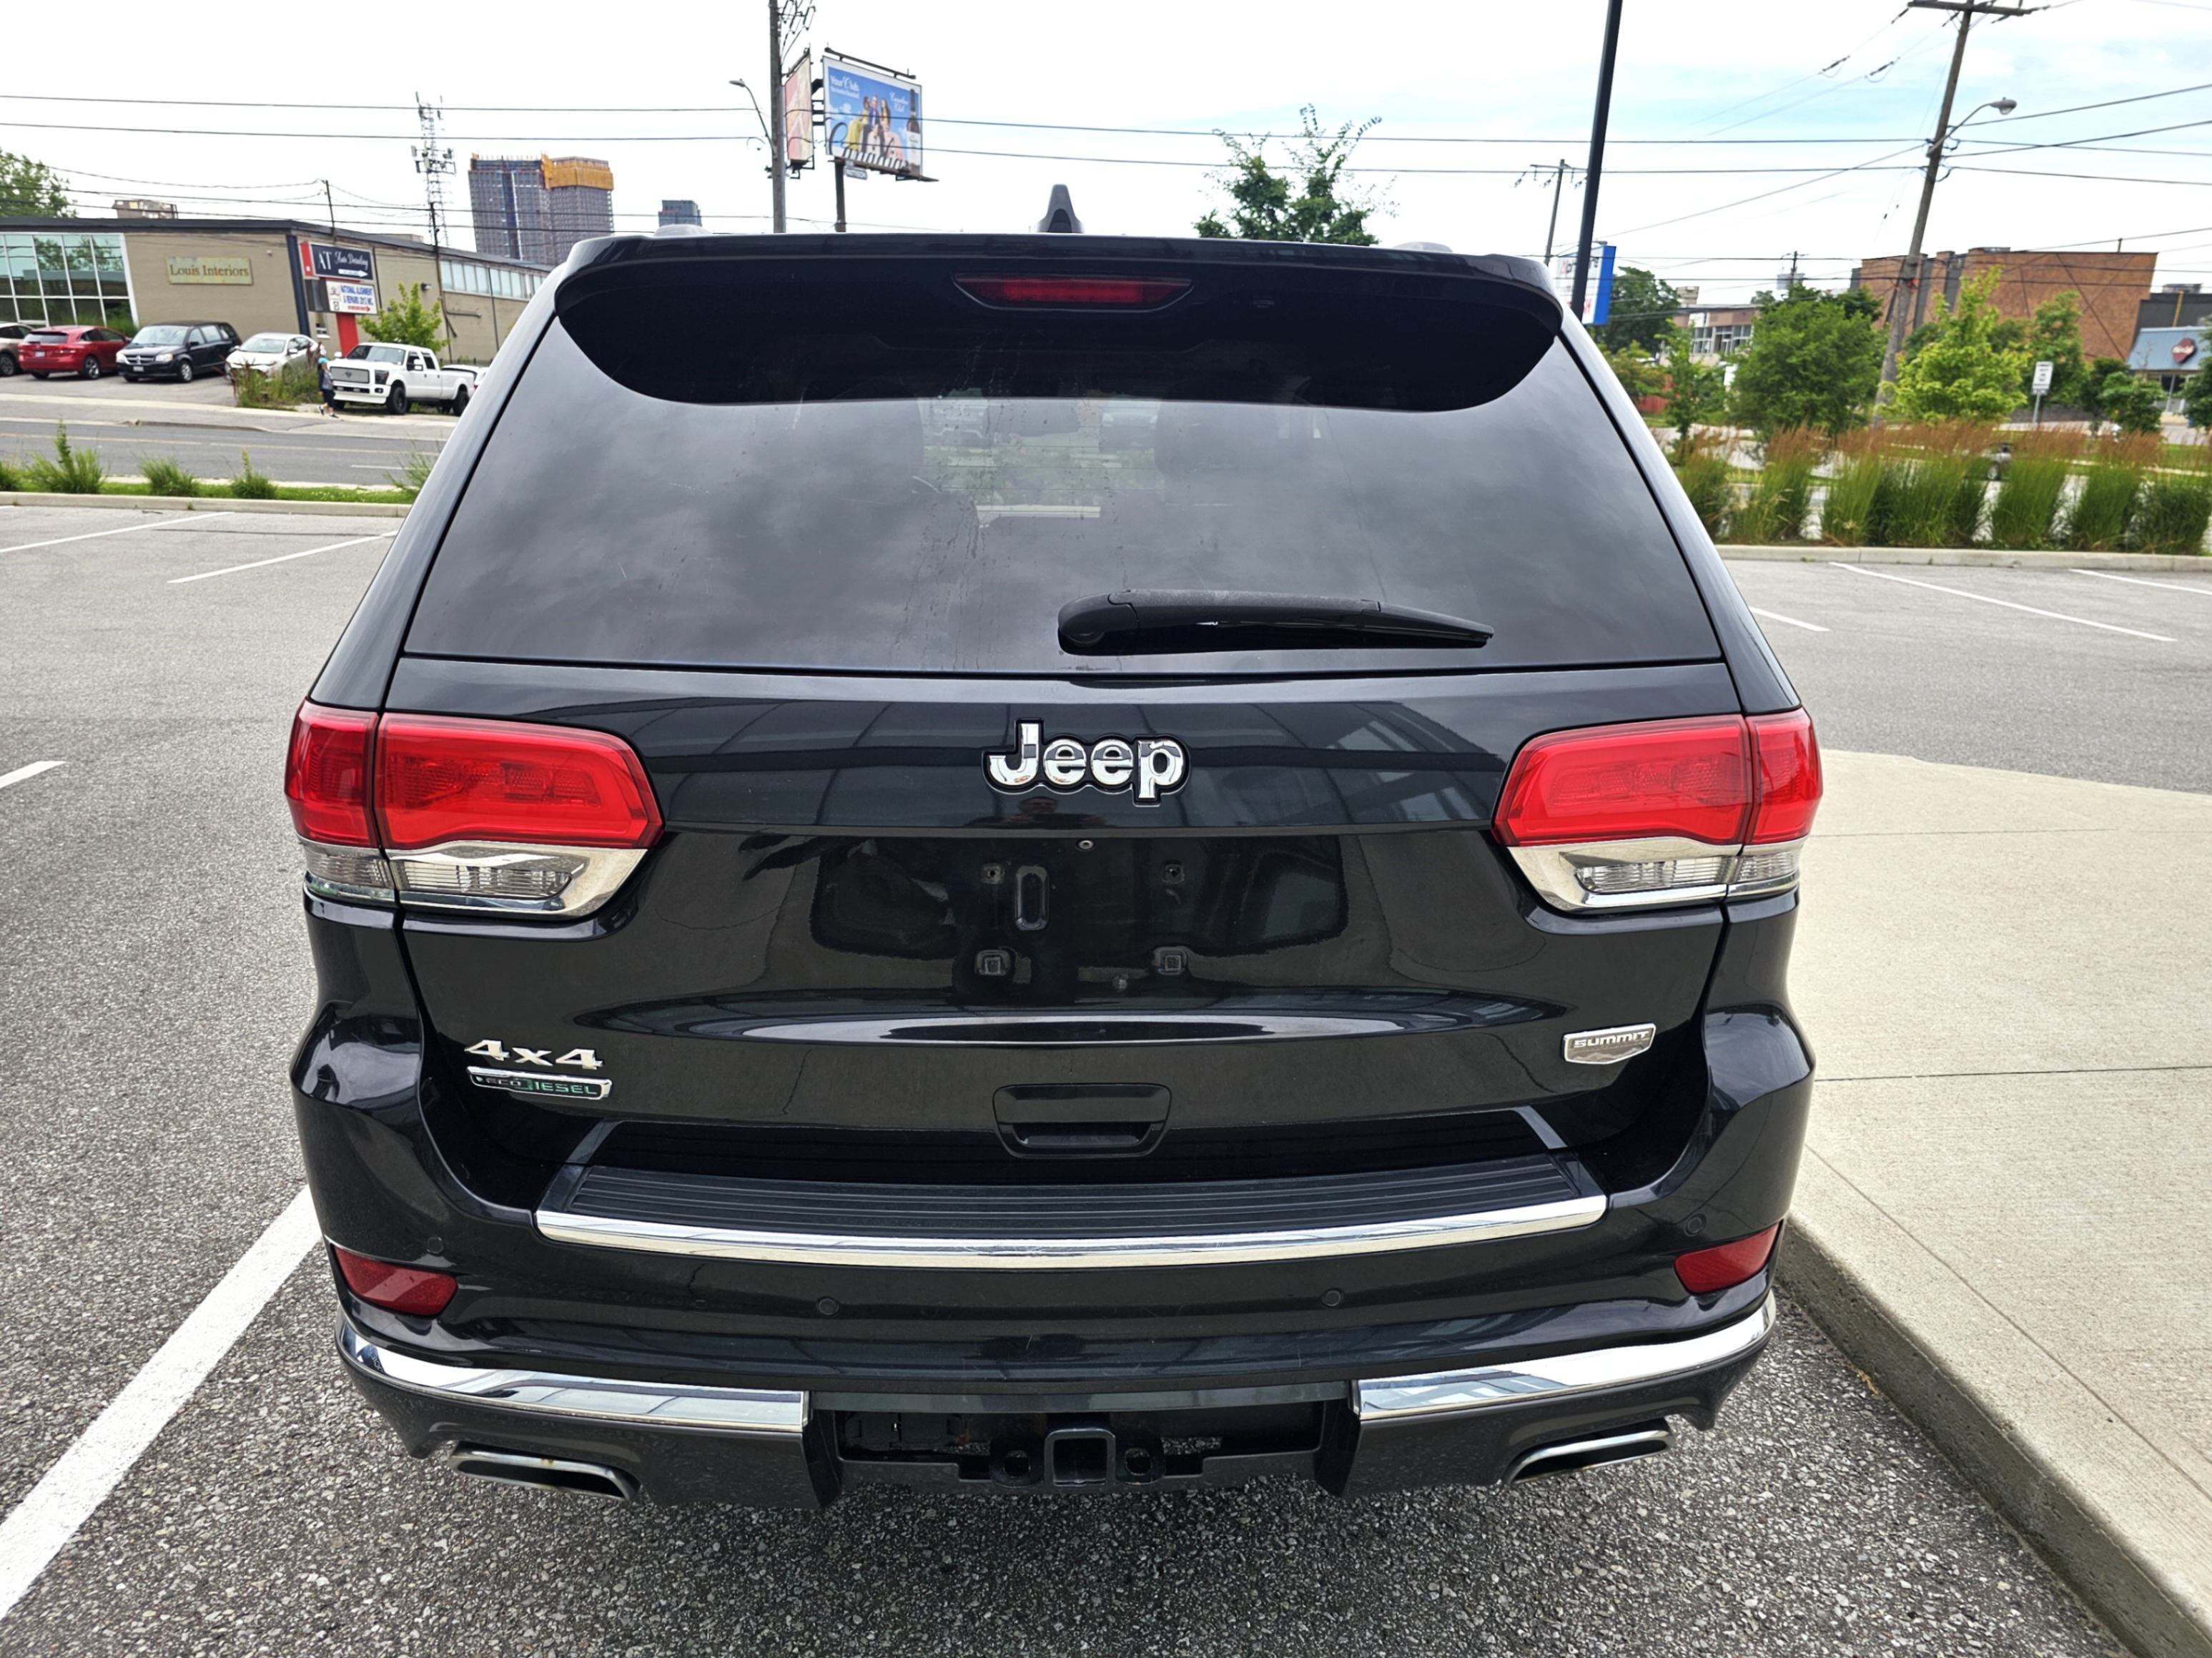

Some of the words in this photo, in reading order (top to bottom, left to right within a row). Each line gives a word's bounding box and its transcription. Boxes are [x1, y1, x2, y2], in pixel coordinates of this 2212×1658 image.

[170, 264, 200, 276] Louis
[202, 265, 250, 277] Interiors
[988, 722, 1184, 799] Jeep
[1574, 1031, 1649, 1048] SUMMIT
[464, 1039, 603, 1070] 4x4
[485, 1077, 598, 1095] ECODIESEL
